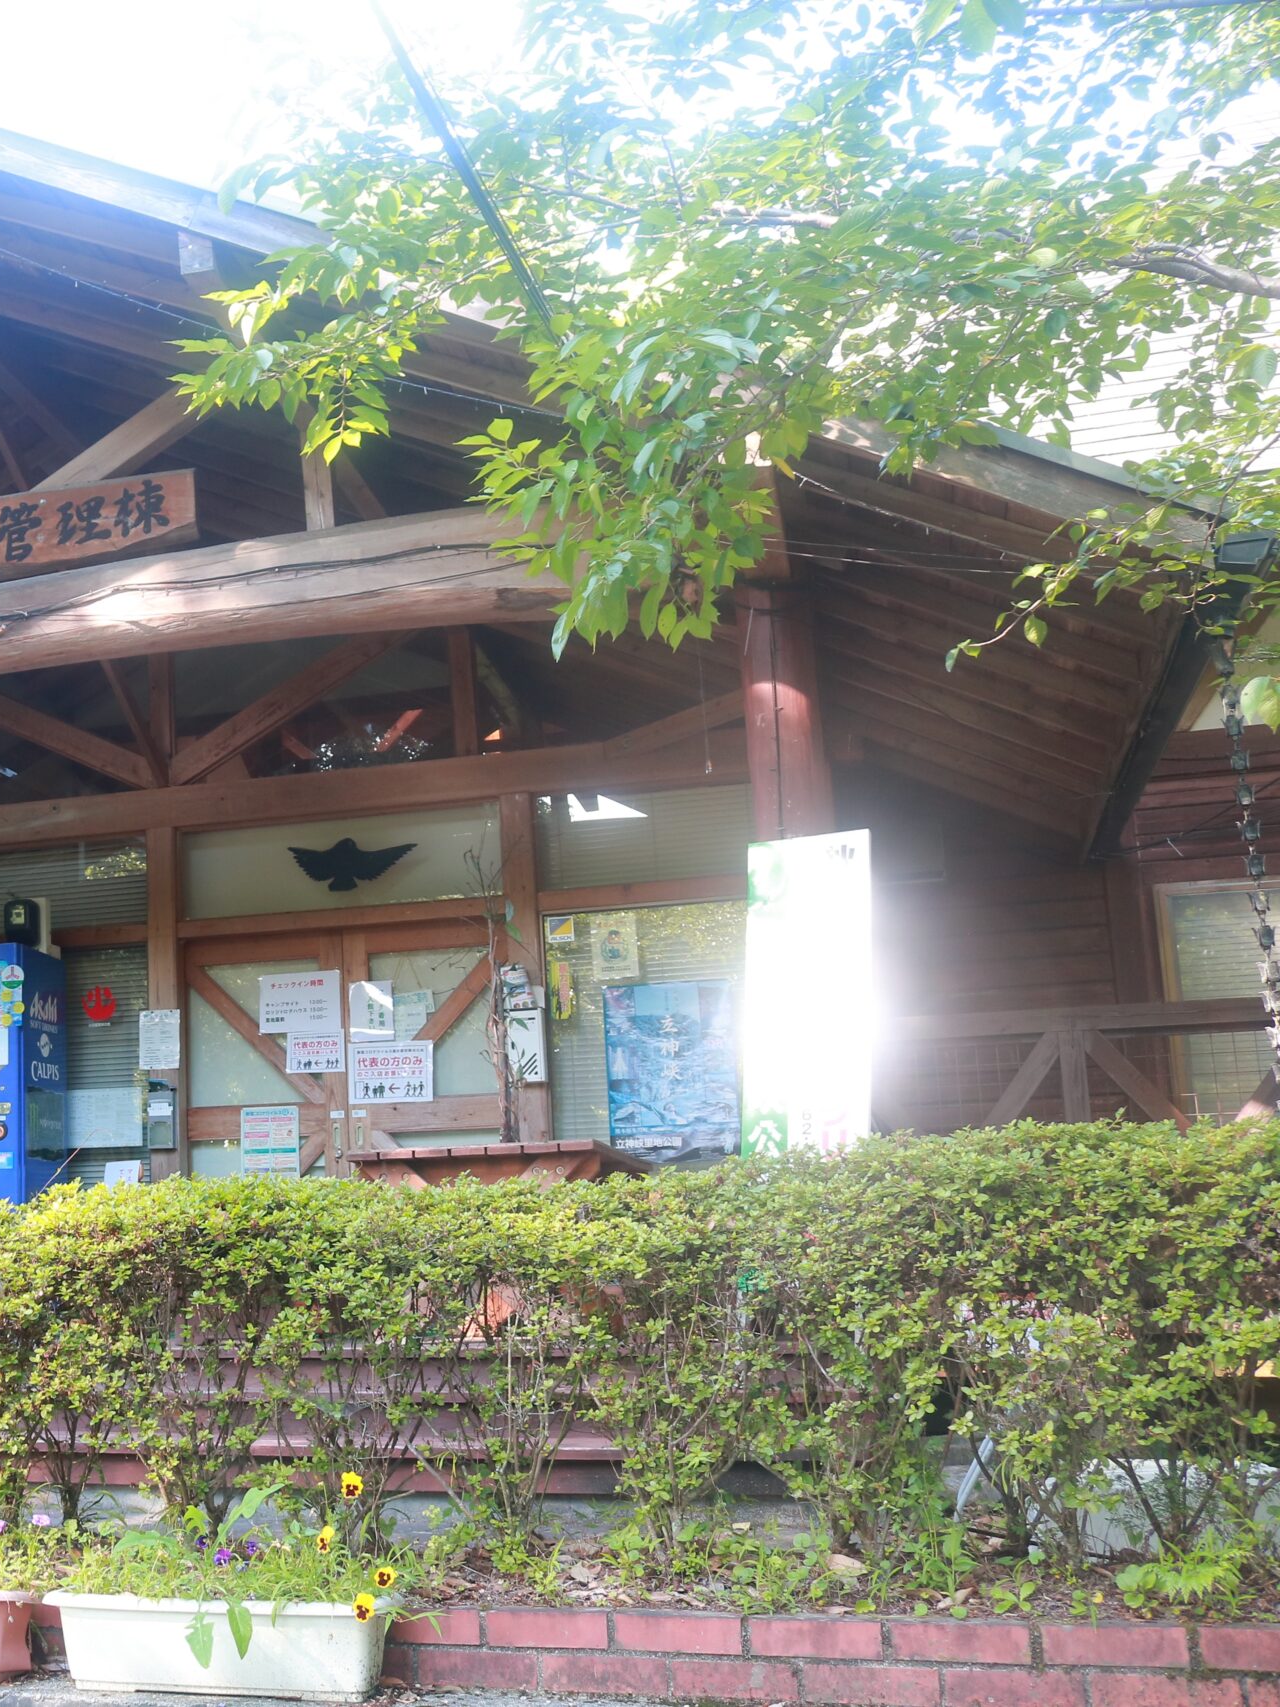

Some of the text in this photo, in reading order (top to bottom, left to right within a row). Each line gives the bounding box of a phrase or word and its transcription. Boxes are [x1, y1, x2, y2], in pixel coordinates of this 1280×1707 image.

[270, 979, 324, 989] チェックイン時間
[29, 992, 58, 1024] Asahi
[293, 1040, 338, 1049] 代表の方のみ
[357, 1056, 423, 1068] 代表の方のみ
[31, 1060, 60, 1081] CALPIS
[615, 1136, 682, 1149] 立神峡里地公園
